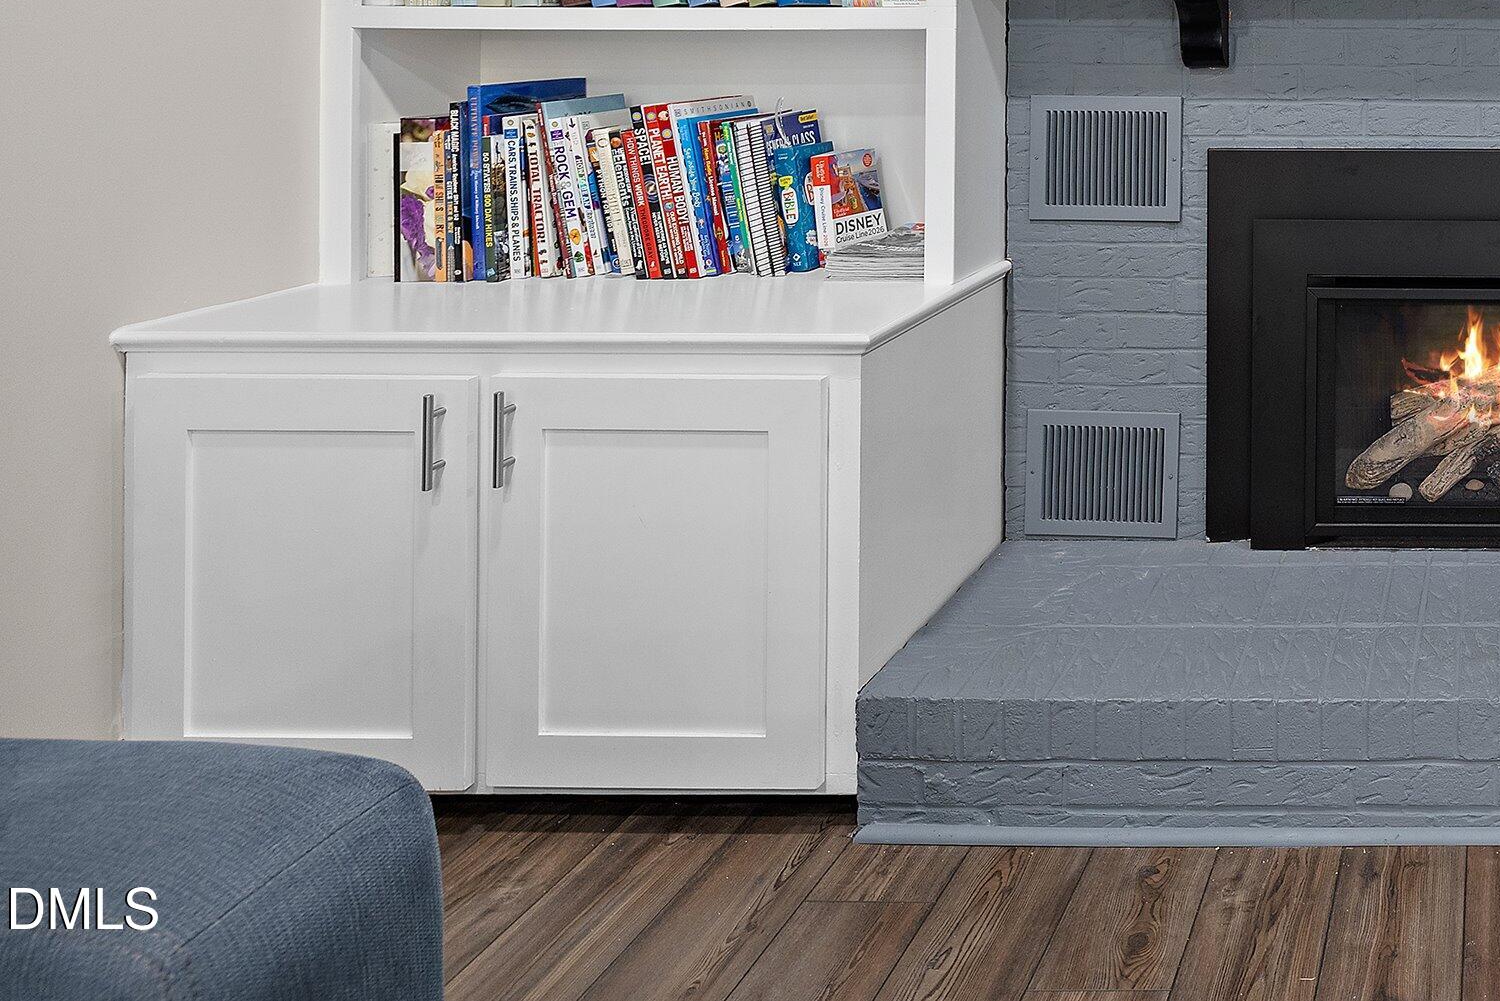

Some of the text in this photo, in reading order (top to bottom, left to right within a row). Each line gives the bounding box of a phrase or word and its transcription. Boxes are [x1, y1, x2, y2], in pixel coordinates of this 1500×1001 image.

[450, 109, 459, 130] BLACK
[469, 97, 479, 136] ULTIMATE
[683, 102, 745, 115] SMITHSONIAN
[451, 131, 460, 152] MAGIC
[633, 127, 650, 165] SPACE!
[792, 130, 816, 146] CLASS
[482, 152, 489, 161] 50
[554, 146, 570, 180] ROCK
[648, 128, 669, 200] PLANET EARTH!
[561, 181, 571, 191] &
[595, 169, 606, 198] PYTHON
[612, 155, 630, 206] Elements
[666, 156, 681, 193] HUMAN
[674, 195, 689, 224] BODY!
[529, 150, 545, 243] TOTAL TRACTOR!
[562, 191, 576, 218] GEM
[576, 159, 585, 176] HOW
[584, 210, 596, 239] Engineer
[602, 200, 610, 214] FOR
[626, 137, 653, 259] HOW THINGS WORK THEODORE GRAY
[692, 191, 702, 207] Body
[484, 208, 492, 223] DAY
[510, 197, 519, 222] SHIPS
[485, 224, 493, 247] HIKES
[604, 216, 614, 232] KIDS
[835, 213, 882, 235] DISNEY
[835, 226, 885, 243] Cruise Line 2026
[512, 229, 521, 262] PLANES
